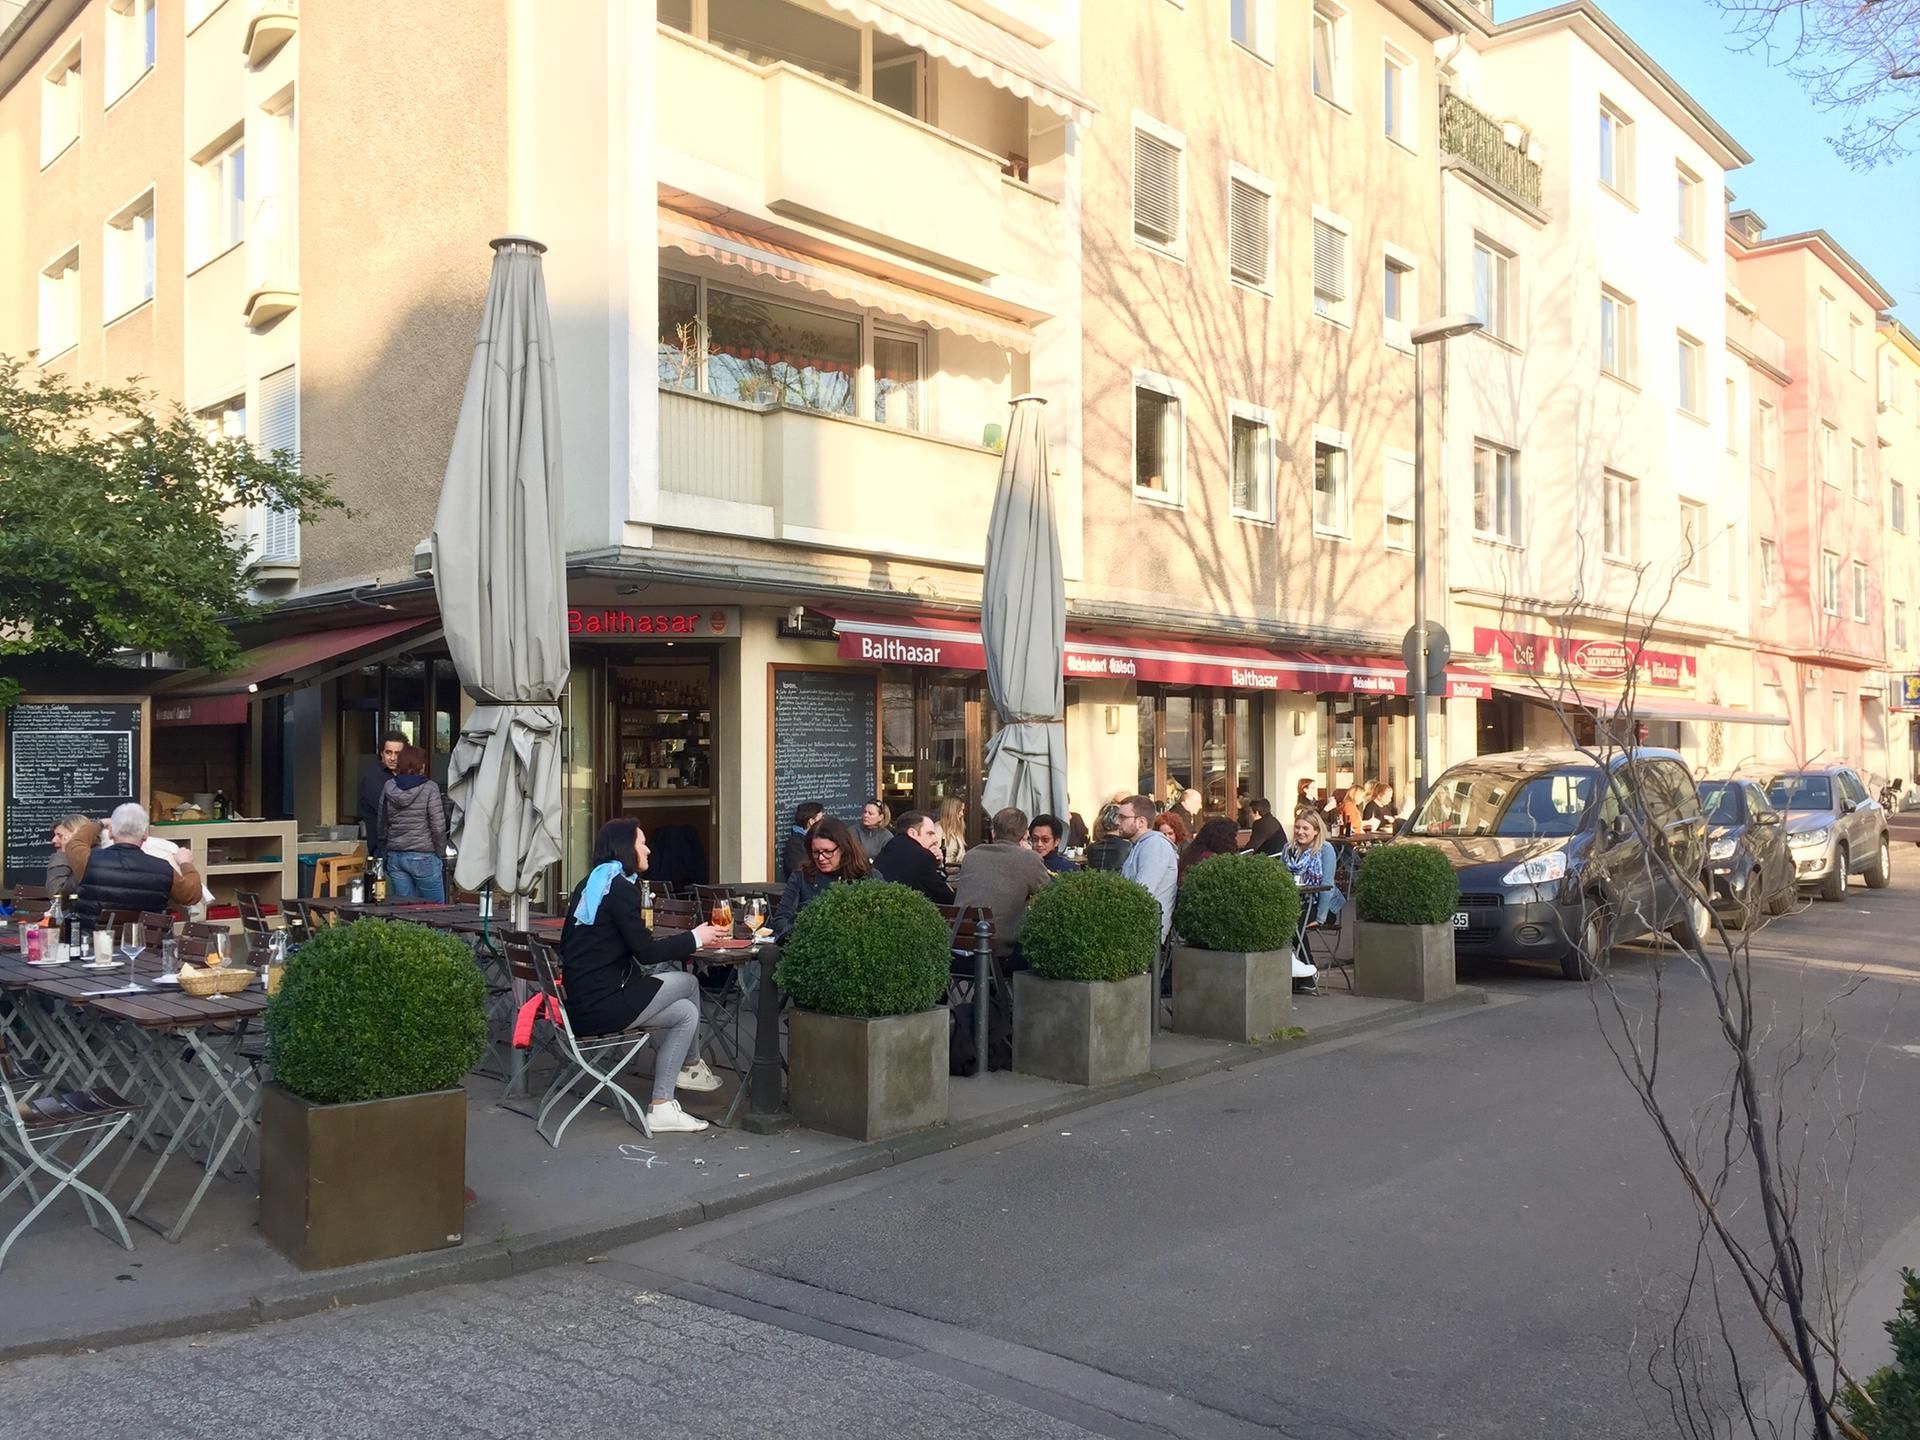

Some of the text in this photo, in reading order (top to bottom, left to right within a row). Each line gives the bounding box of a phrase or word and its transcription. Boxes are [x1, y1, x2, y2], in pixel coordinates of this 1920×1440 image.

[568, 610, 700, 634] Balthasar
[861, 637, 941, 663] Balthasar
[1513, 644, 1535, 666] Café
[1231, 668, 1279, 688] Balthasar
[1453, 683, 1483, 697] Balthasar
[1453, 914, 1467, 925] 65
